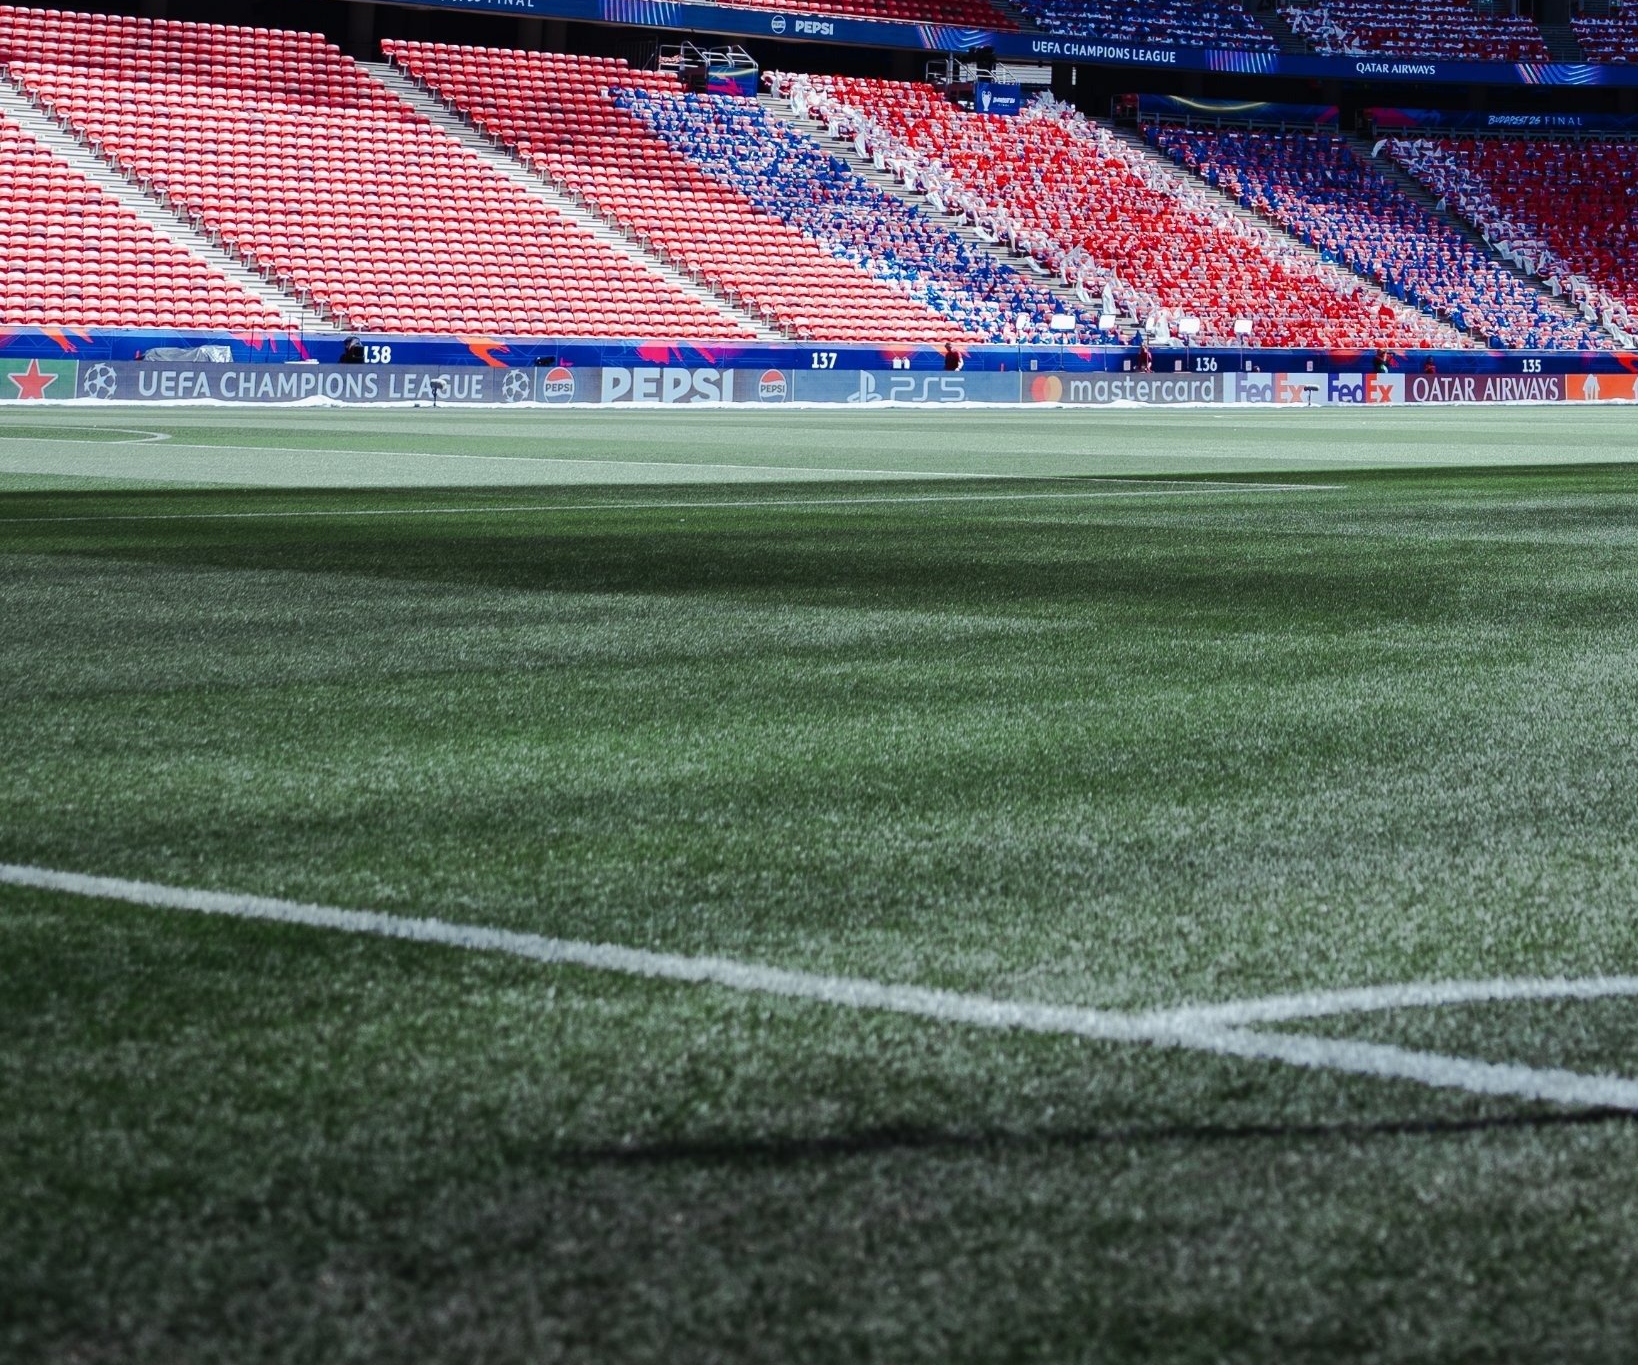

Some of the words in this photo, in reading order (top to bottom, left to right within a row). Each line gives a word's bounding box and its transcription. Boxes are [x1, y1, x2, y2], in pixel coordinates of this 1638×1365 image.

[795, 19, 834, 35] PEPSI
[1032, 40, 1061, 54] UEFA
[1063, 43, 1130, 60] CHAMPIONS
[1132, 49, 1176, 63] LEAGUE
[1356, 62, 1389, 74] QATAR
[1391, 64, 1436, 75] AIRWAYS
[1528, 116, 1541, 125] 26
[1545, 116, 1583, 126] FINAL
[811, 352, 838, 369] 137
[1195, 357, 1217, 372] 136
[1522, 359, 1541, 373] 135
[138, 370, 213, 397] UEFA
[219, 371, 378, 399] CHAMPIONS
[389, 373, 484, 399] LEAGUE
[545, 382, 574, 393] PEPSI
[601, 367, 735, 403] PEPSI
[760, 383, 785, 394] PEPSI
[890, 377, 966, 402] PS5
[1070, 376, 1215, 402] mastercard
[1236, 373, 1305, 403] FedEx
[1328, 373, 1394, 403] FedEx
[1412, 377, 1476, 402] QATAR
[1484, 377, 1559, 402] AIRWAYS
